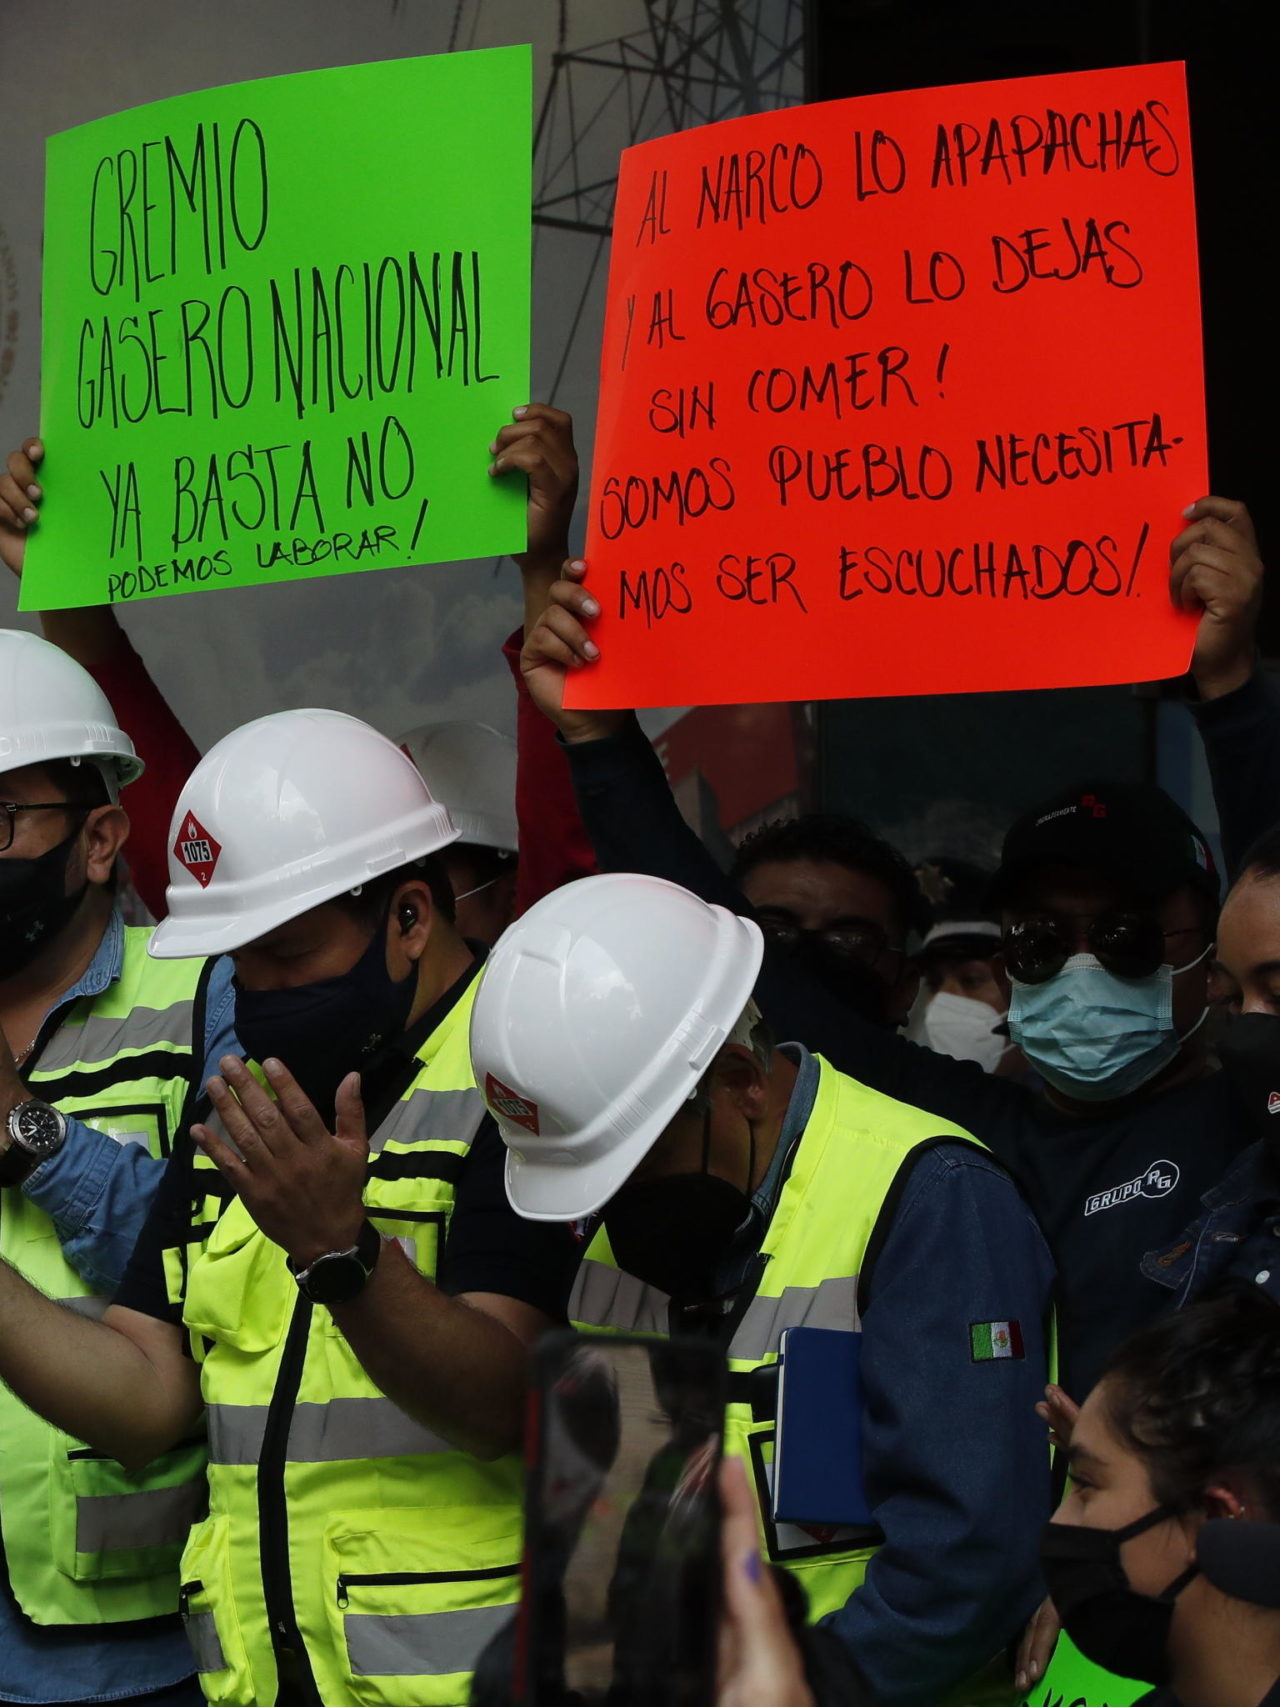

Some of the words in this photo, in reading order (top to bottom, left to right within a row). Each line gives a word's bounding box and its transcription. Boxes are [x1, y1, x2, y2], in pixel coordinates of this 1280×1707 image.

[90, 118, 268, 302] GREMIO
[635, 169, 671, 248] AL
[696, 142, 823, 231] NARCO
[854, 130, 906, 202] LO
[931, 100, 1179, 189] APAPACHAS
[646, 290, 686, 349] AL
[705, 260, 873, 329] GASERO
[903, 249, 965, 304] LO
[991, 217, 1143, 294] DEJAS
[76, 285, 254, 430] GASERO
[270, 251, 500, 420] NACIONAL
[648, 382, 715, 438] SIN
[99, 461, 143, 562] YA
[172, 440, 325, 552] BASTA
[346, 416, 414, 508] NO
[599, 457, 736, 541] SOMOS
[768, 445, 953, 506] PUEBLO
[107, 550, 233, 602] PODEMOS
[619, 561, 692, 629] MOS
[716, 552, 808, 614] SER
[183, 840, 211, 863] 1075
[1090, 1180, 1142, 1212] GRUPO
